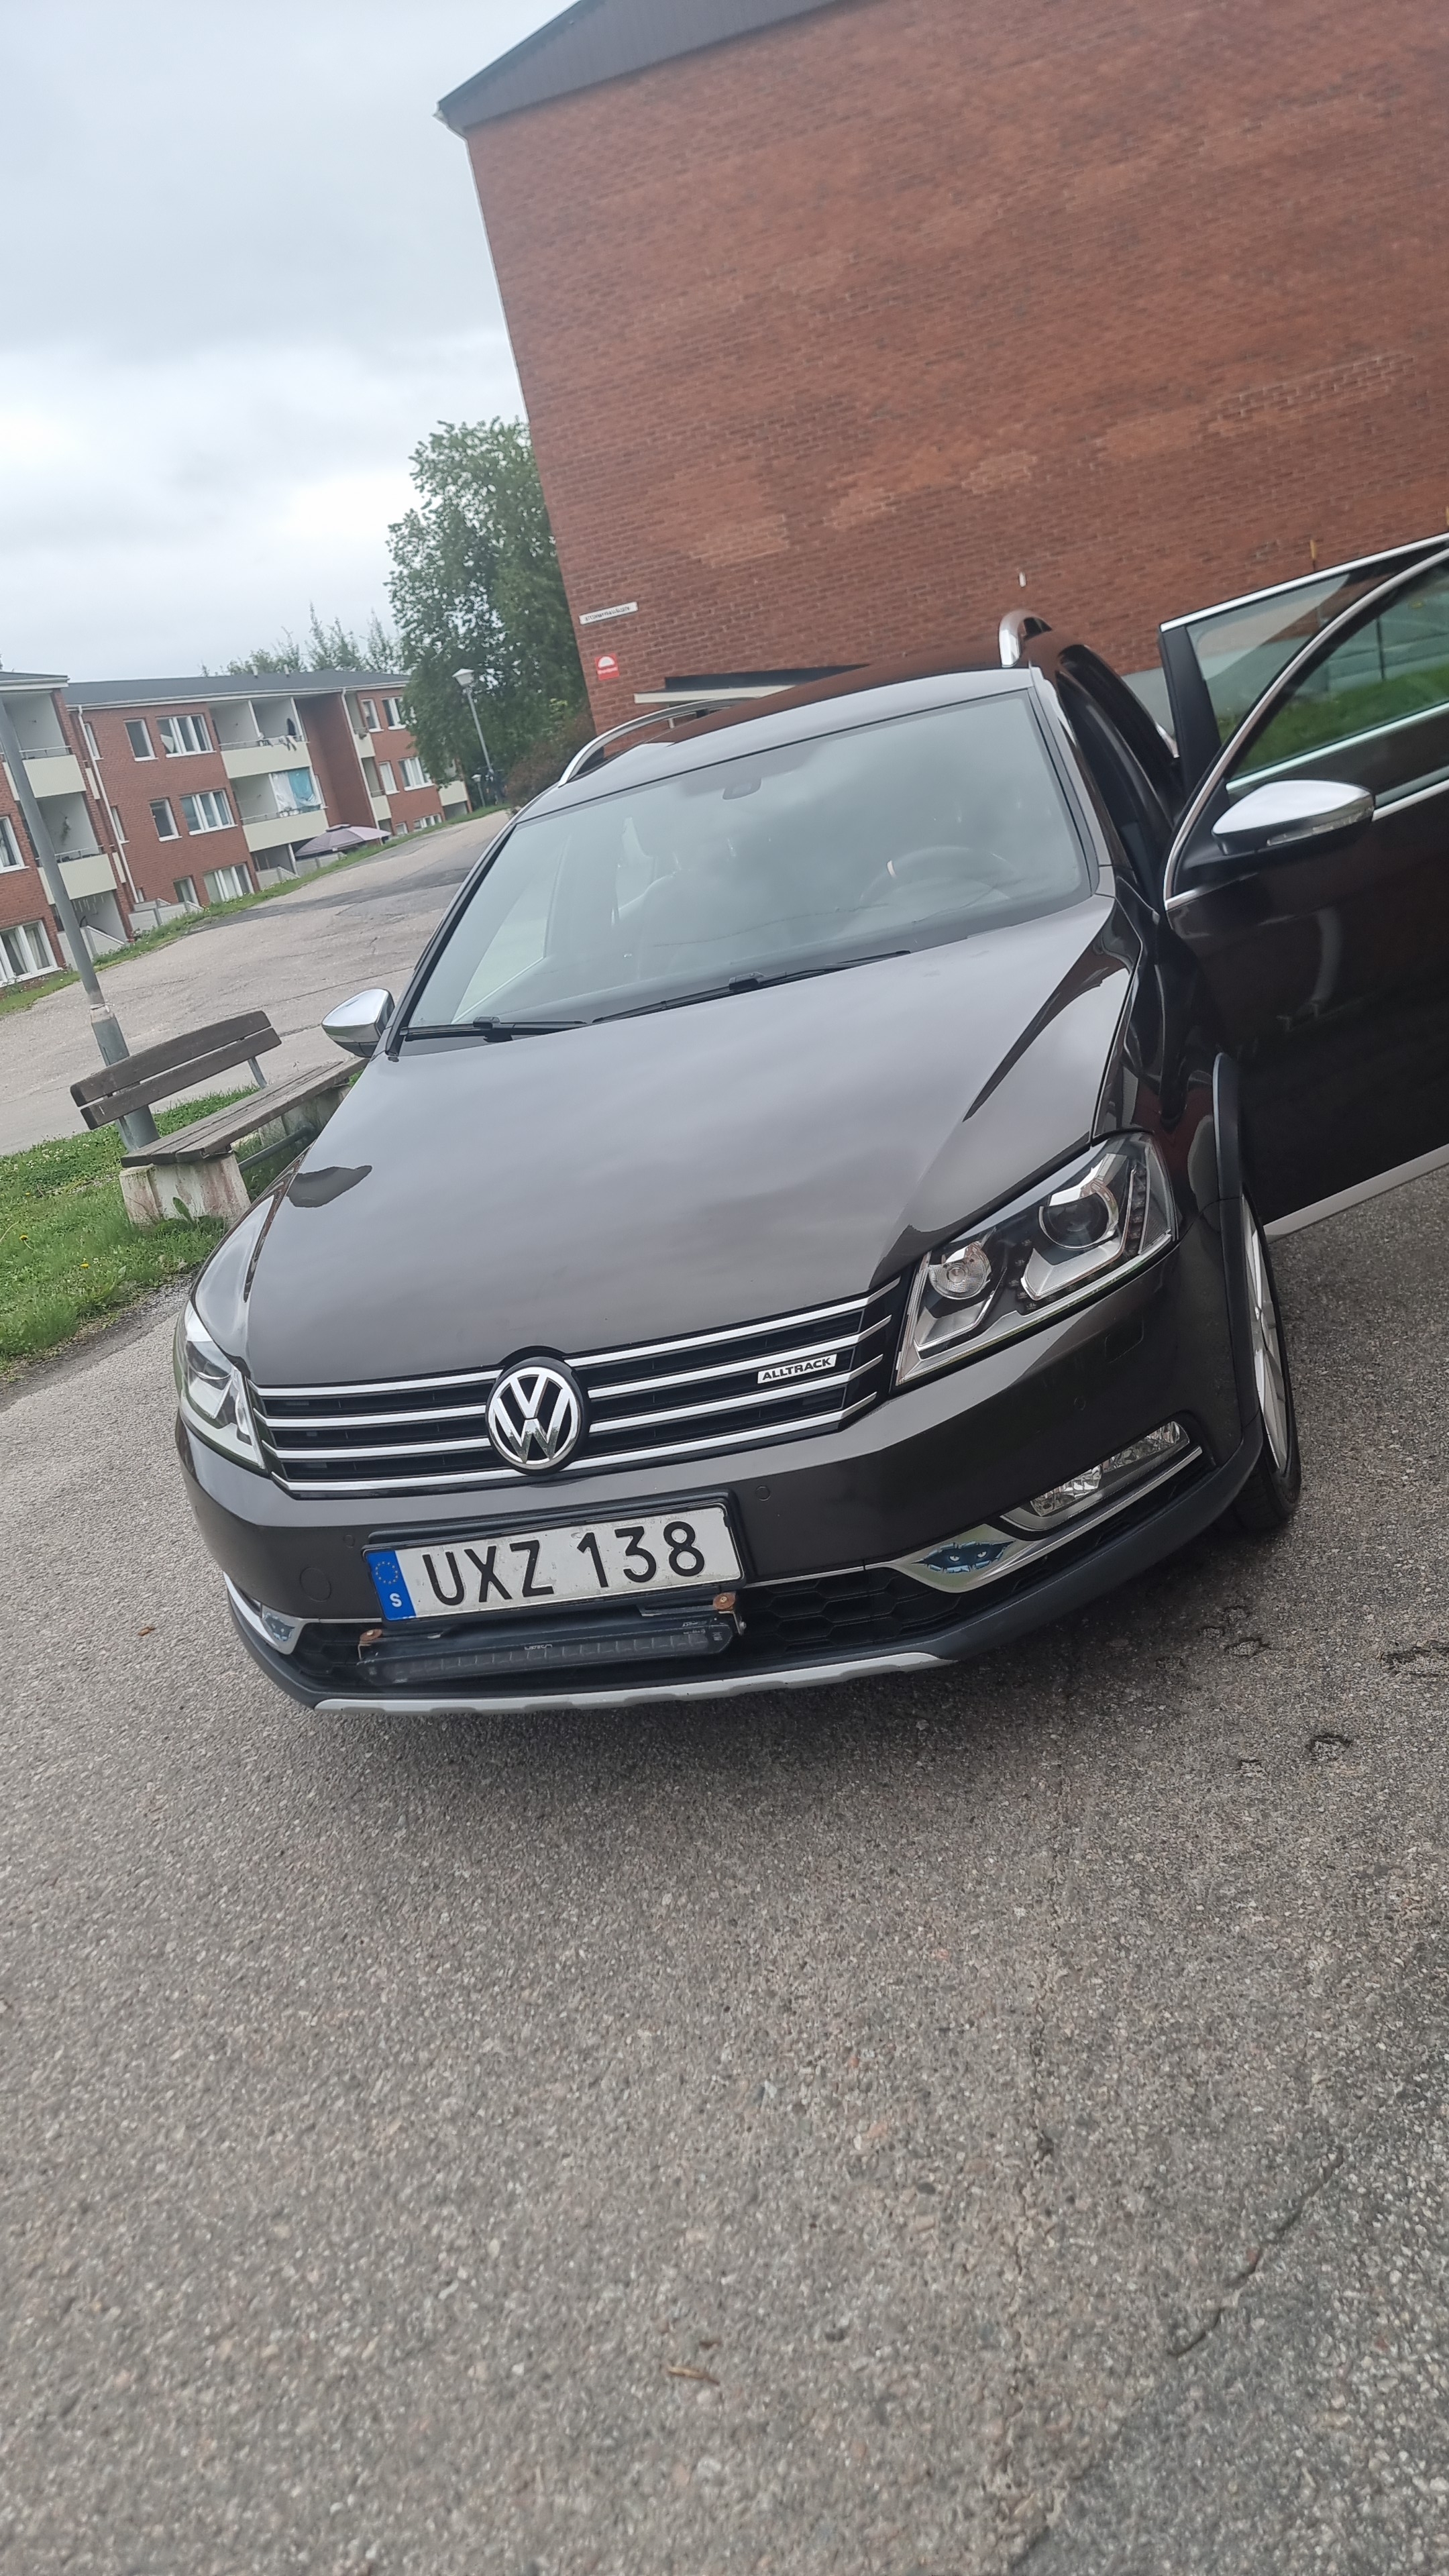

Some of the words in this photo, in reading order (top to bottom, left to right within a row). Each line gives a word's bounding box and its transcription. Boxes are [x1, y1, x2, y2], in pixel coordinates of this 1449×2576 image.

[762, 1357, 832, 1381] ALLTRACK
[489, 1367, 578, 1465] VW
[422, 1539, 555, 1607] UXZ
[576, 1521, 705, 1589] 138
[390, 1591, 402, 1608] S
